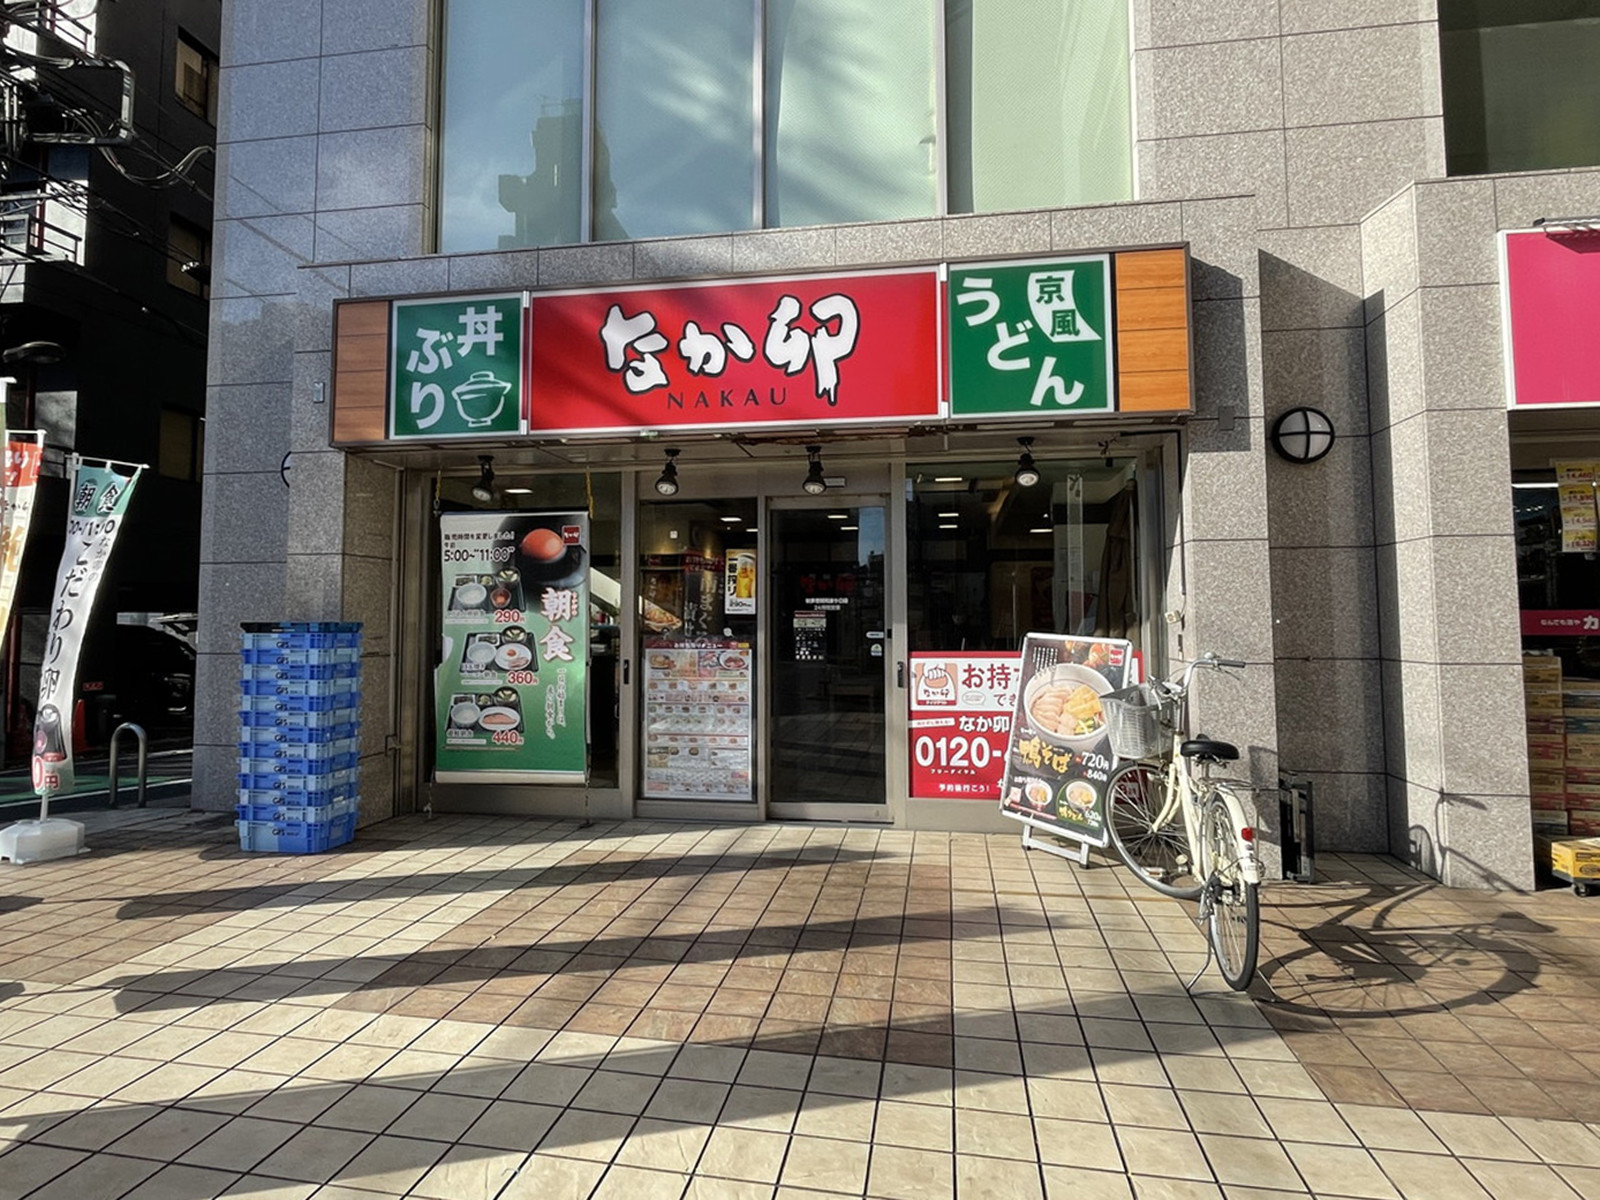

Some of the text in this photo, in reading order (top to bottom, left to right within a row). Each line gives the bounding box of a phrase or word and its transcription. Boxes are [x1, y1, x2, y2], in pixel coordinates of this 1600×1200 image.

[1034, 275, 1080, 338] 京風
[600, 293, 859, 405] なか卯
[956, 277, 1085, 407] うどん
[667, 387, 788, 410] NAKAU
[75, 483, 118, 512] 朝食
[40, 540, 92, 700] こだわり卵
[541, 587, 574, 662] 朝食
[959, 715, 1010, 732] なか卯
[915, 736, 1009, 768] 0120-
[1018, 735, 1073, 774] 鴨そば
[930, 768, 976, 777] フリーダイヤル
